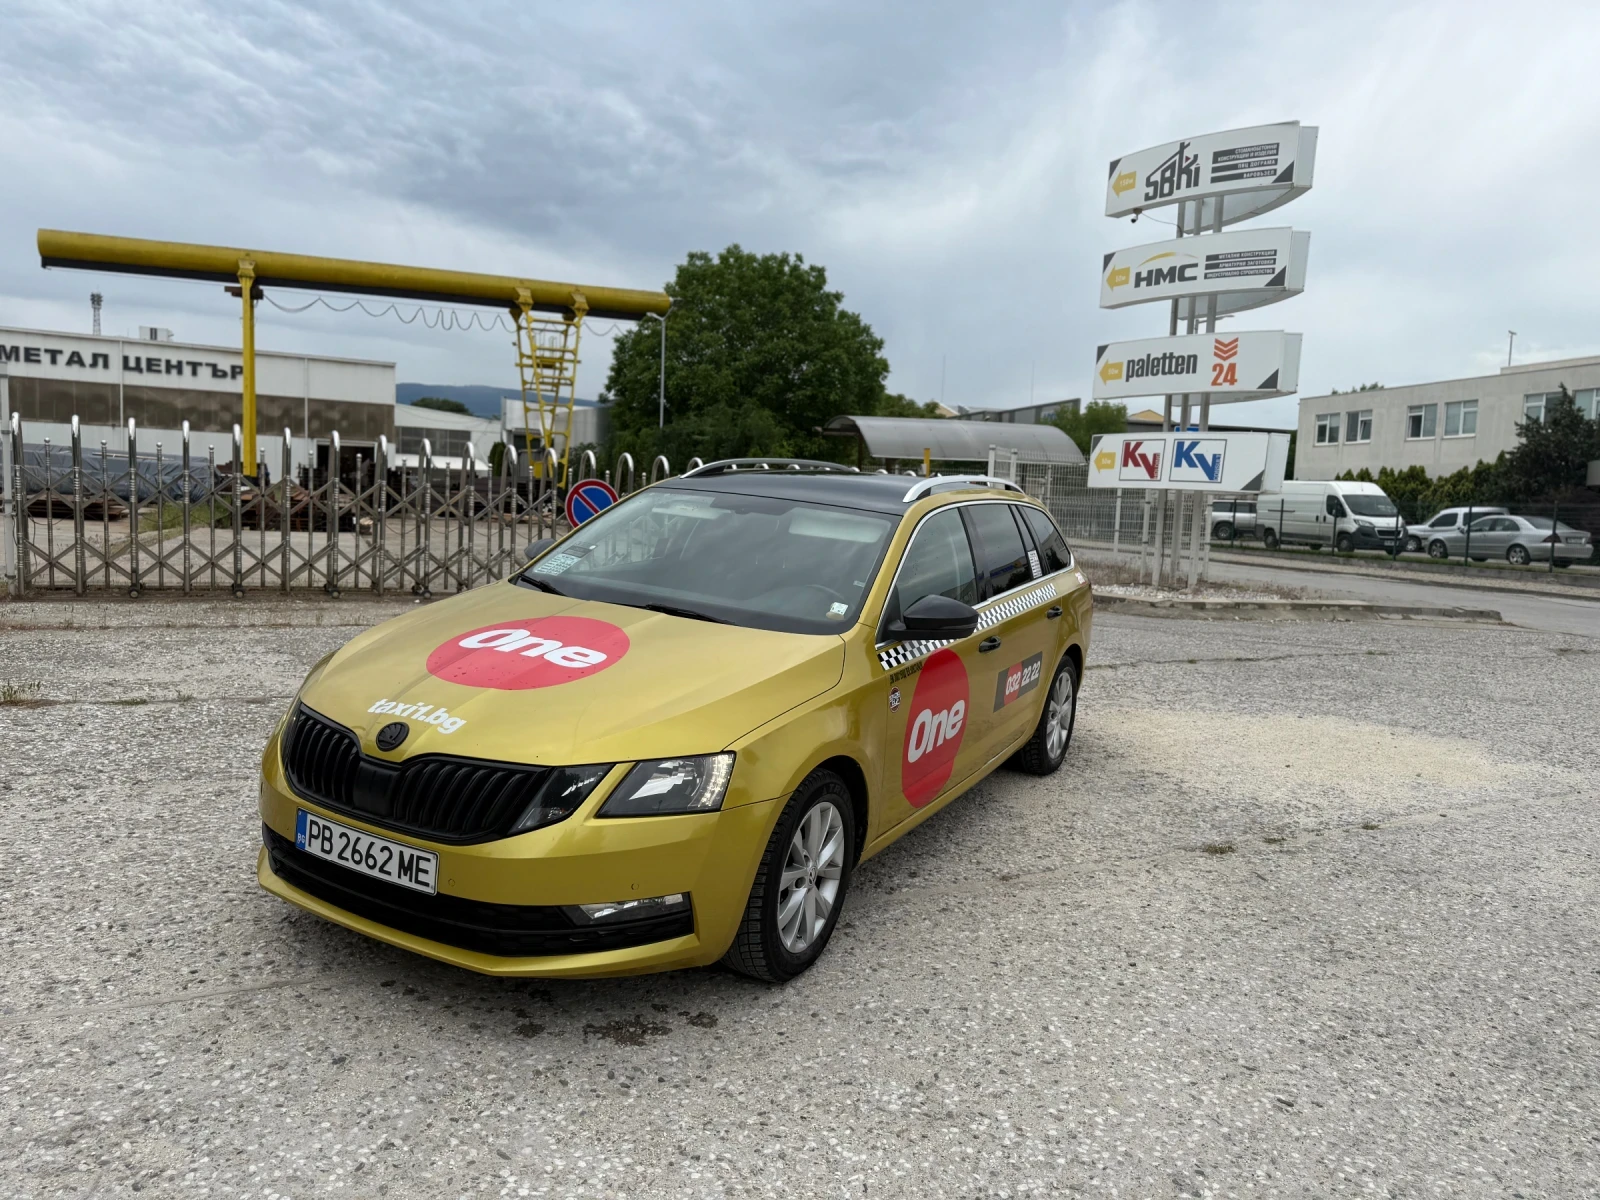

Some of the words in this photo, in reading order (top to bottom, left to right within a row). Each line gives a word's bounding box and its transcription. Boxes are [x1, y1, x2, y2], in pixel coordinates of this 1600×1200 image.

[1217, 152, 1249, 162] КОНСТРУКЦИИ
[1249, 159, 1276, 168] ДОГРАМА
[1241, 250, 1275, 258] КОНСТРУКЦИИ
[0, 344, 110, 370] МЕТАЛ
[123, 355, 244, 380] ЦЕНТЪР
[1125, 352, 1198, 382] paletten
[1211, 363, 1238, 386] 24
[458, 628, 608, 668] One
[1005, 671, 1021, 696] 032
[1021, 665, 1032, 688] 22
[1030, 660, 1041, 681] 22
[907, 699, 966, 763] One
